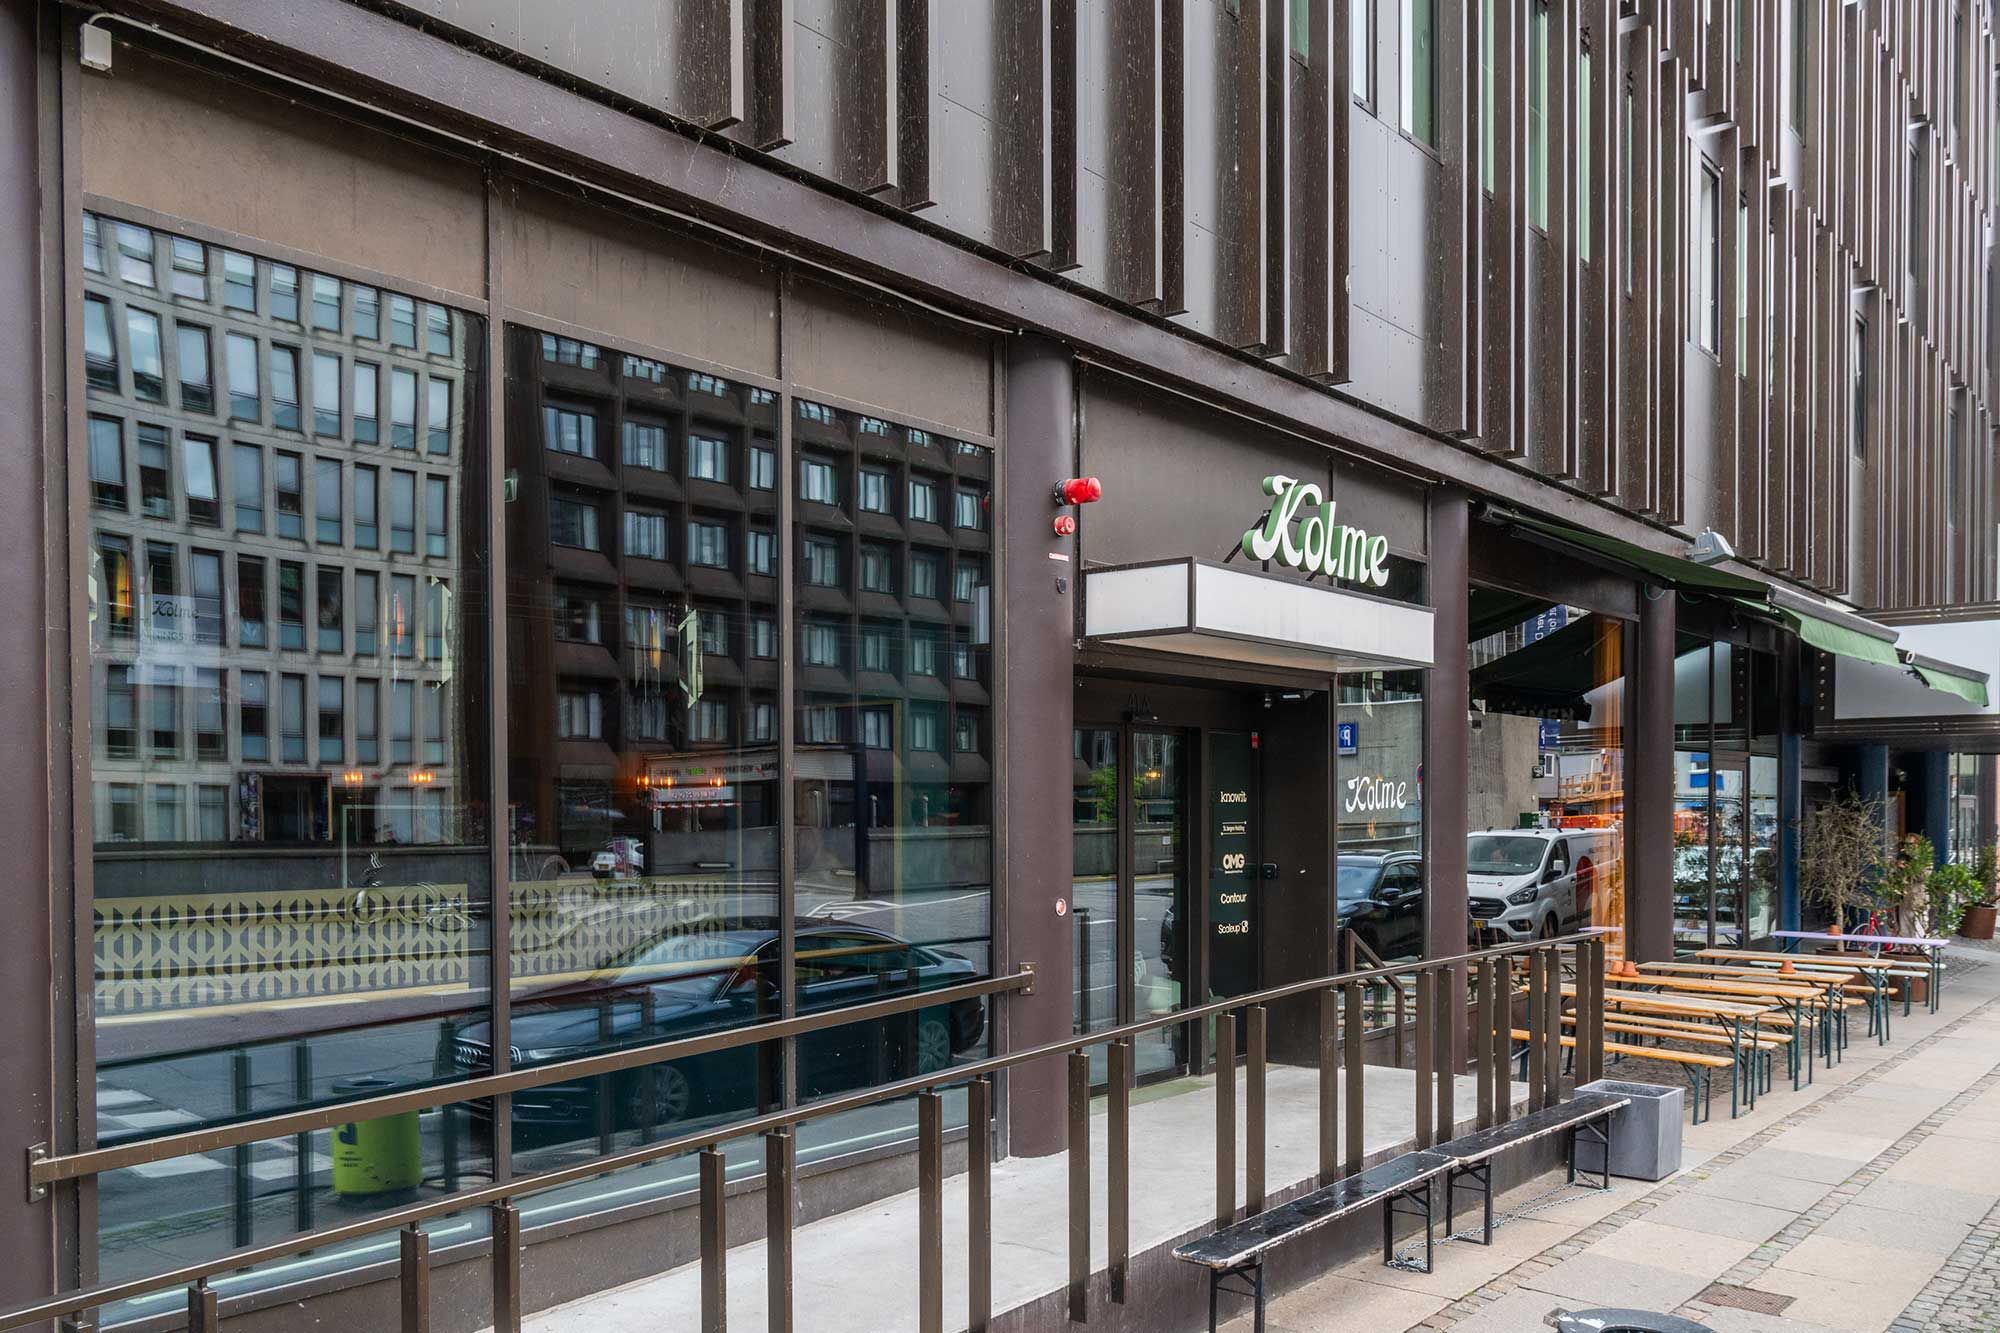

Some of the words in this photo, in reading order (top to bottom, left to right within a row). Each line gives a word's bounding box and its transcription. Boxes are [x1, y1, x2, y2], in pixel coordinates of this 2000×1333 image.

[1243, 475, 1390, 587] Kolme
[152, 600, 199, 619] Kolme
[1345, 776, 1407, 813] Kolme
[1223, 853, 1245, 870] OMG
[1220, 893, 1247, 904] Contour
